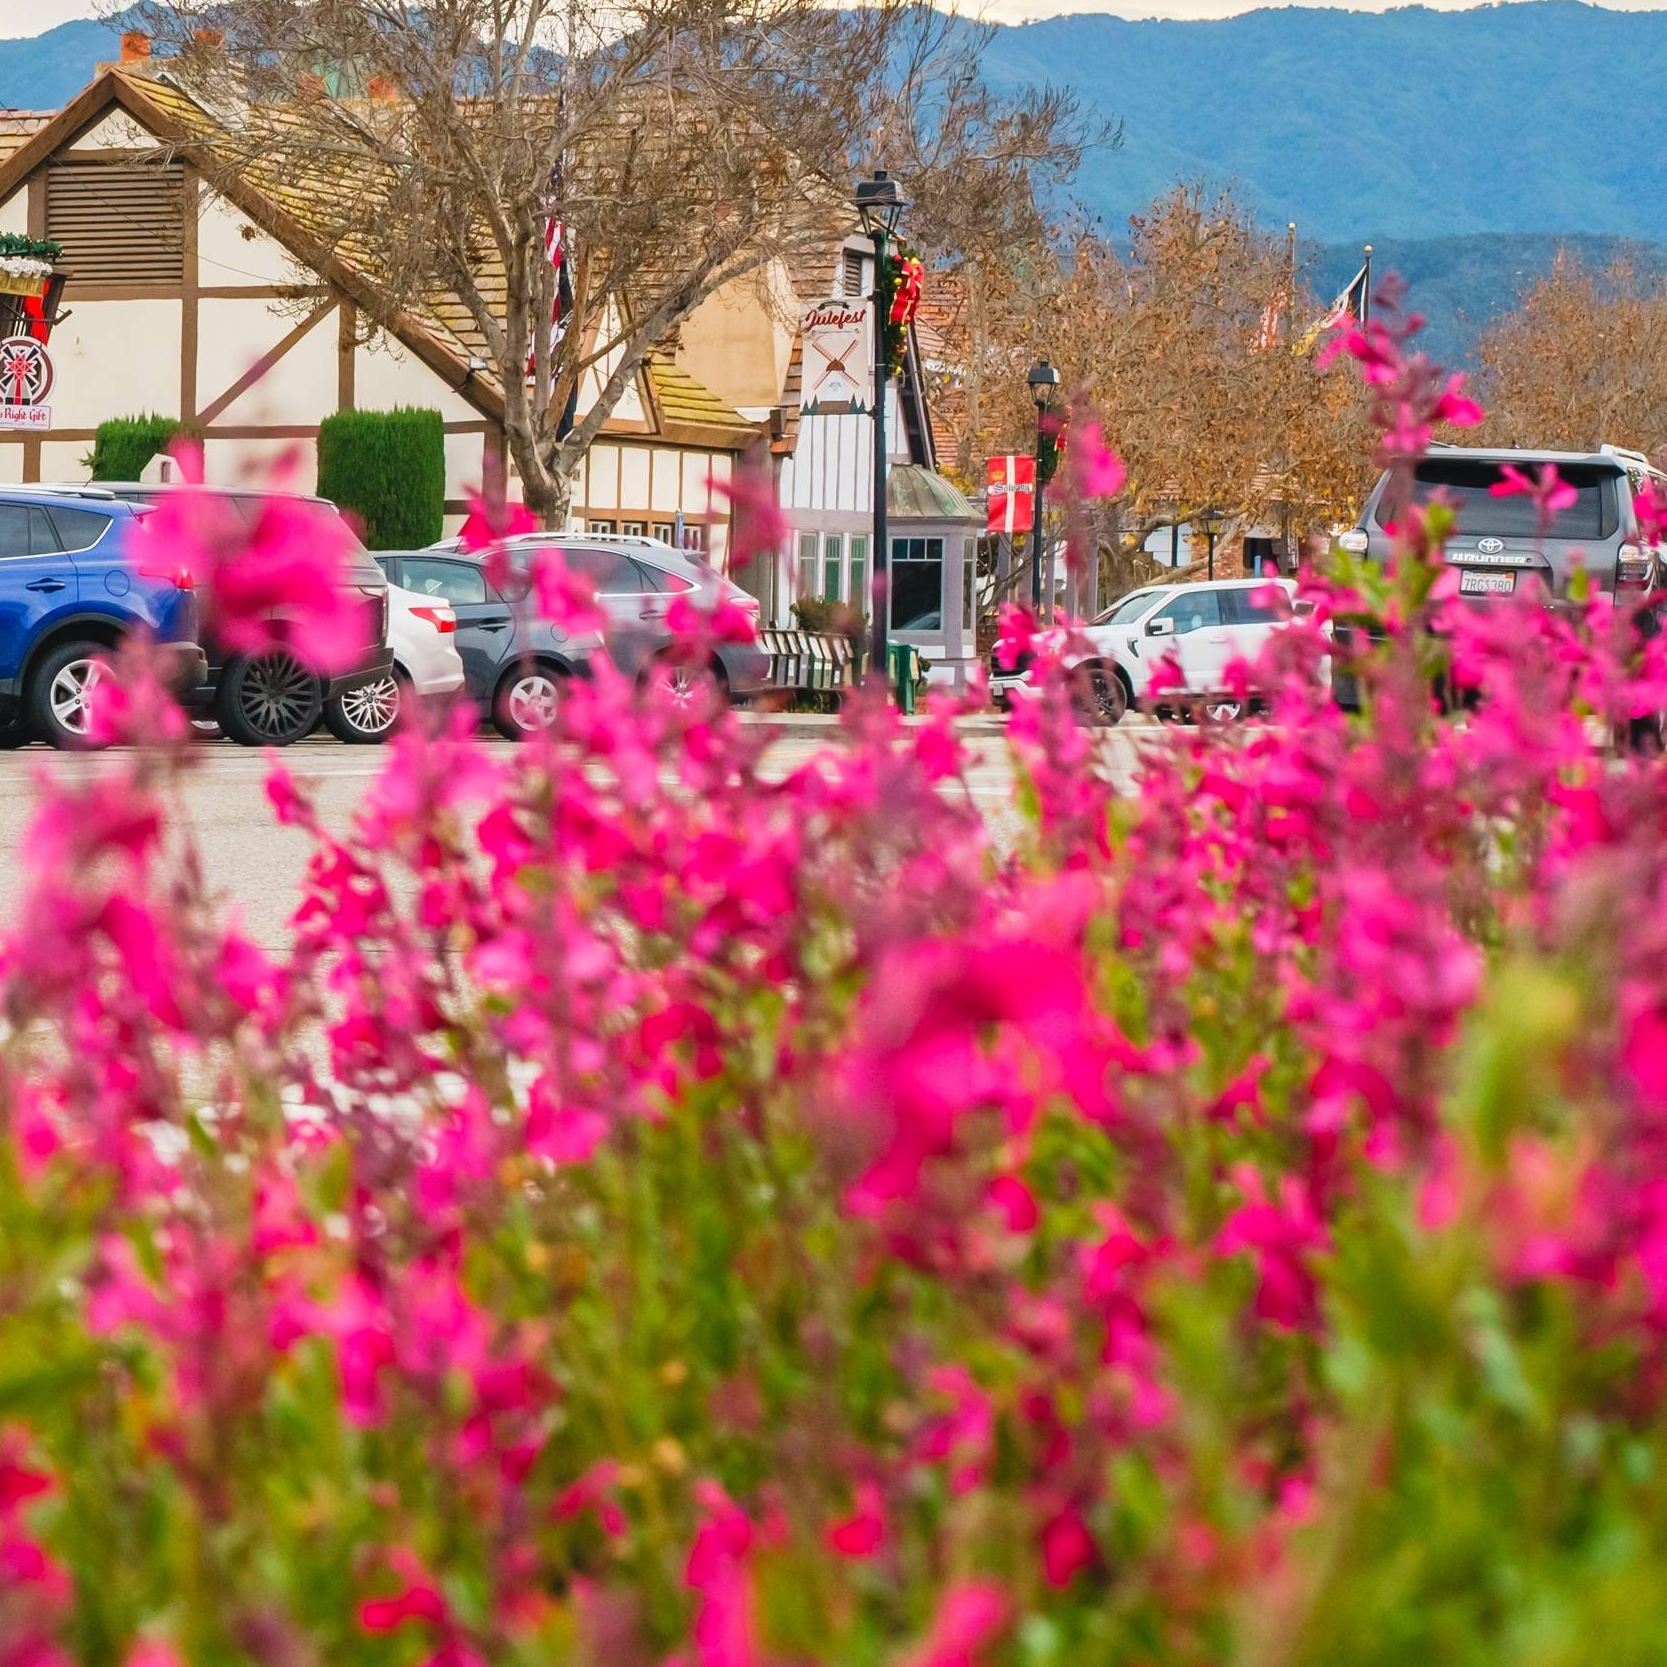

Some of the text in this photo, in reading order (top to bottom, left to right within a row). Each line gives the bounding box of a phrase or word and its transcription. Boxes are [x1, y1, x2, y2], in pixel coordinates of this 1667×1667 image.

[802, 309, 866, 333] Julefest
[4, 407, 27, 421] Right
[29, 408, 47, 422] Gift
[993, 482, 1030, 494] Solvang
[1452, 553, 1526, 563] 4RUNNER
